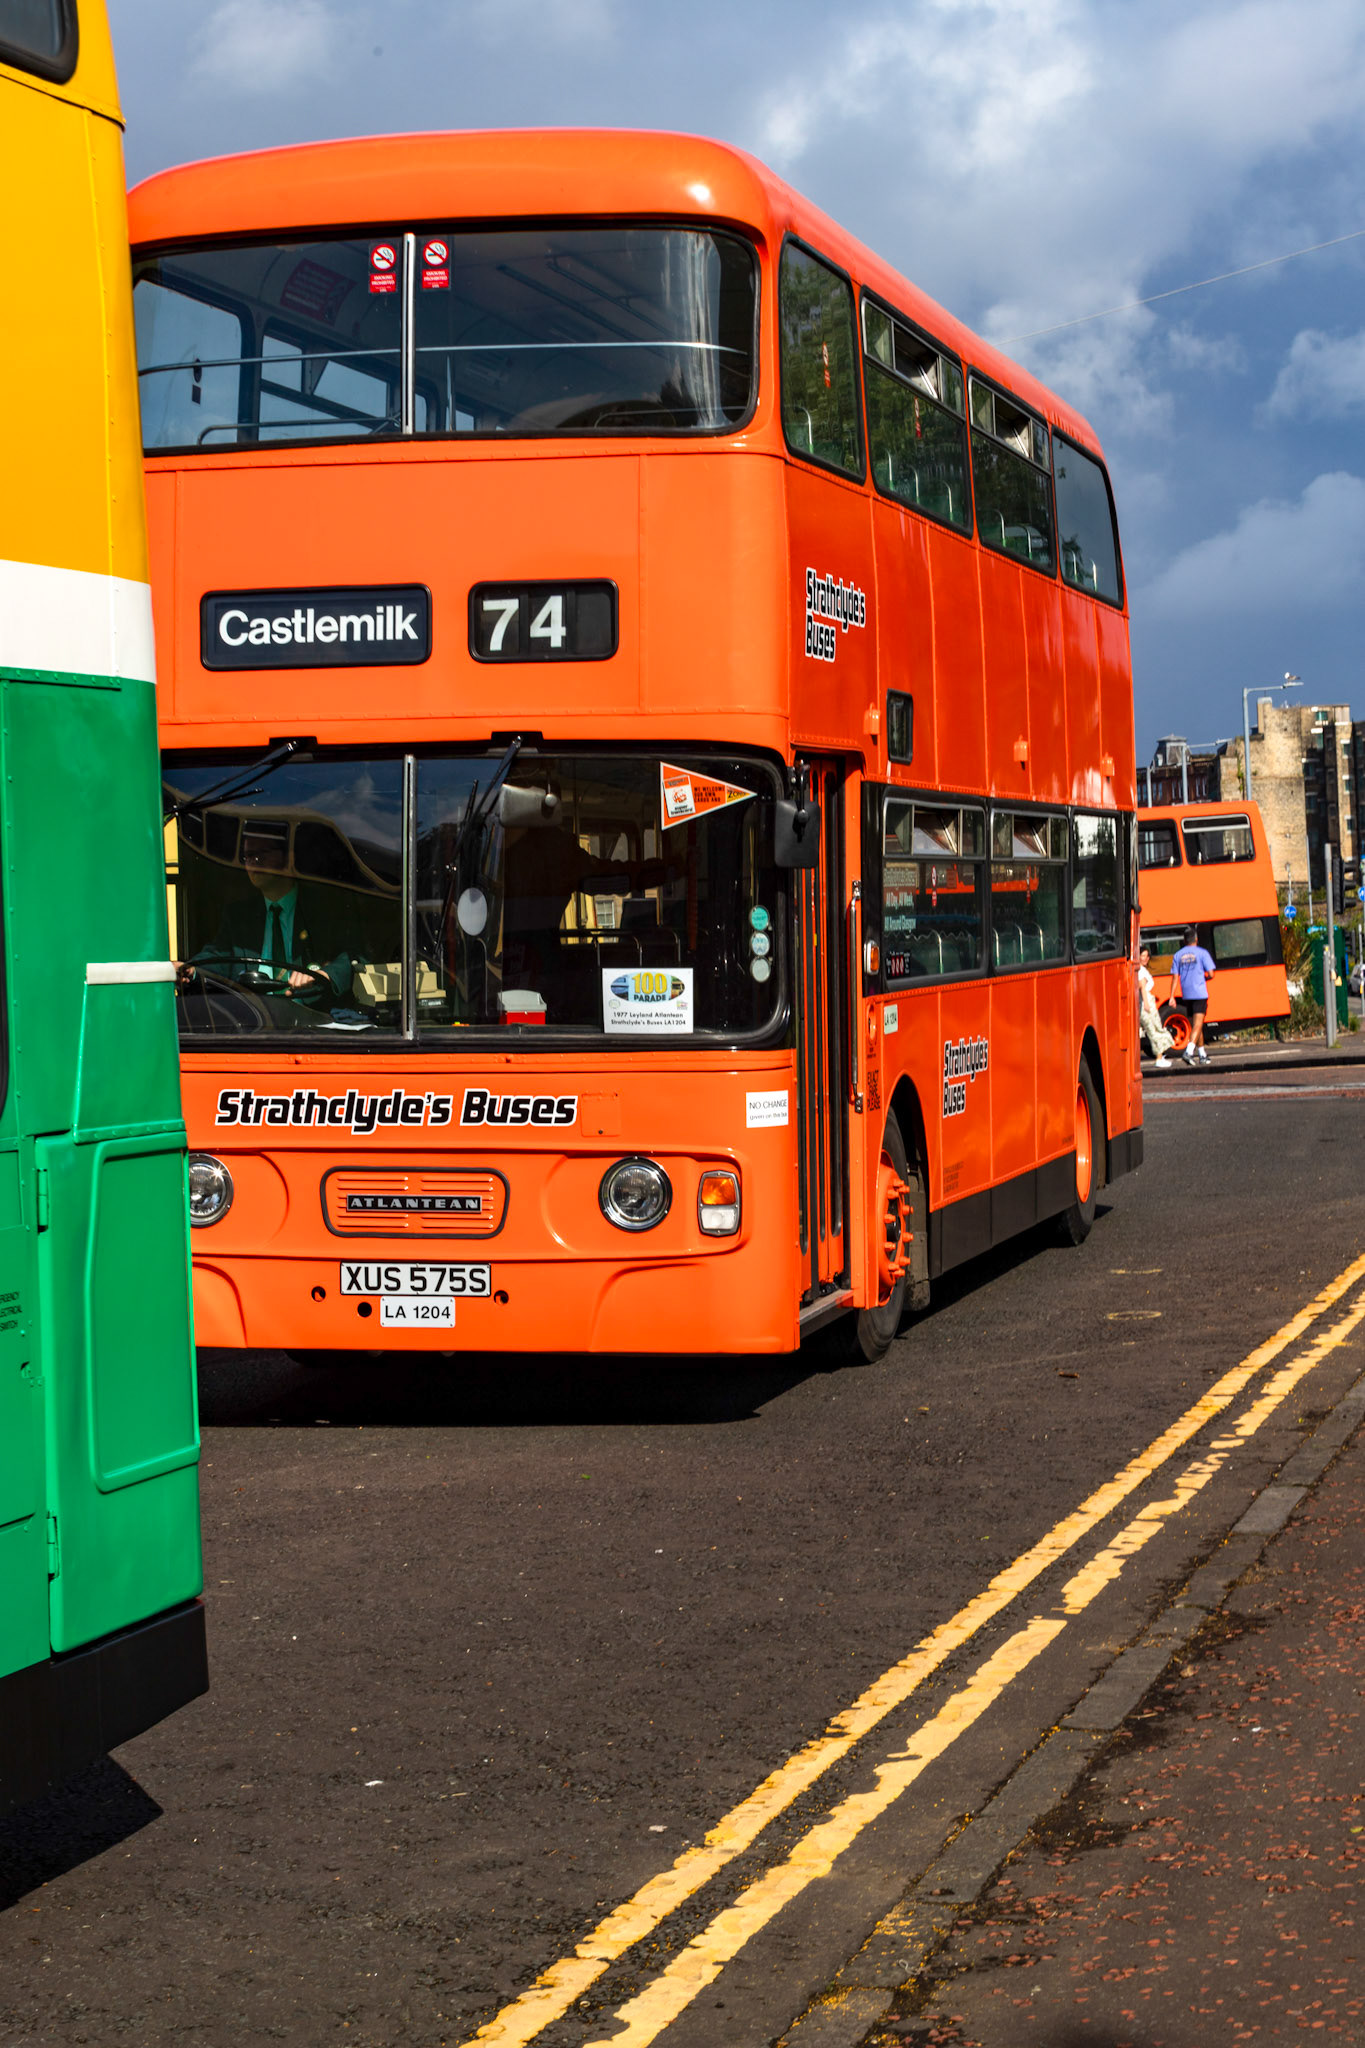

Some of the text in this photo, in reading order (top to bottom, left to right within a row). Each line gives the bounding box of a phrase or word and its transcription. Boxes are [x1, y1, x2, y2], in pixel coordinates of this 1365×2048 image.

[806, 567, 866, 633] Strathclyde's
[219, 605, 419, 647] Castlemilk
[482, 594, 567, 652] 74
[805, 612, 836, 663] Buses
[632, 972, 668, 995] 100
[633, 994, 667, 1003] PARADE
[629, 1011, 653, 1019] Leyland
[943, 1035, 988, 1083] Strathclyde's
[215, 1088, 578, 1135] Strathclyde's Buses
[749, 1099, 787, 1110] NO CHANGE
[942, 1079, 967, 1119] Buses
[350, 1197, 479, 1209] ATLANTEAN
[346, 1266, 487, 1293] XUS 575S
[385, 1305, 451, 1319] LA 1204
